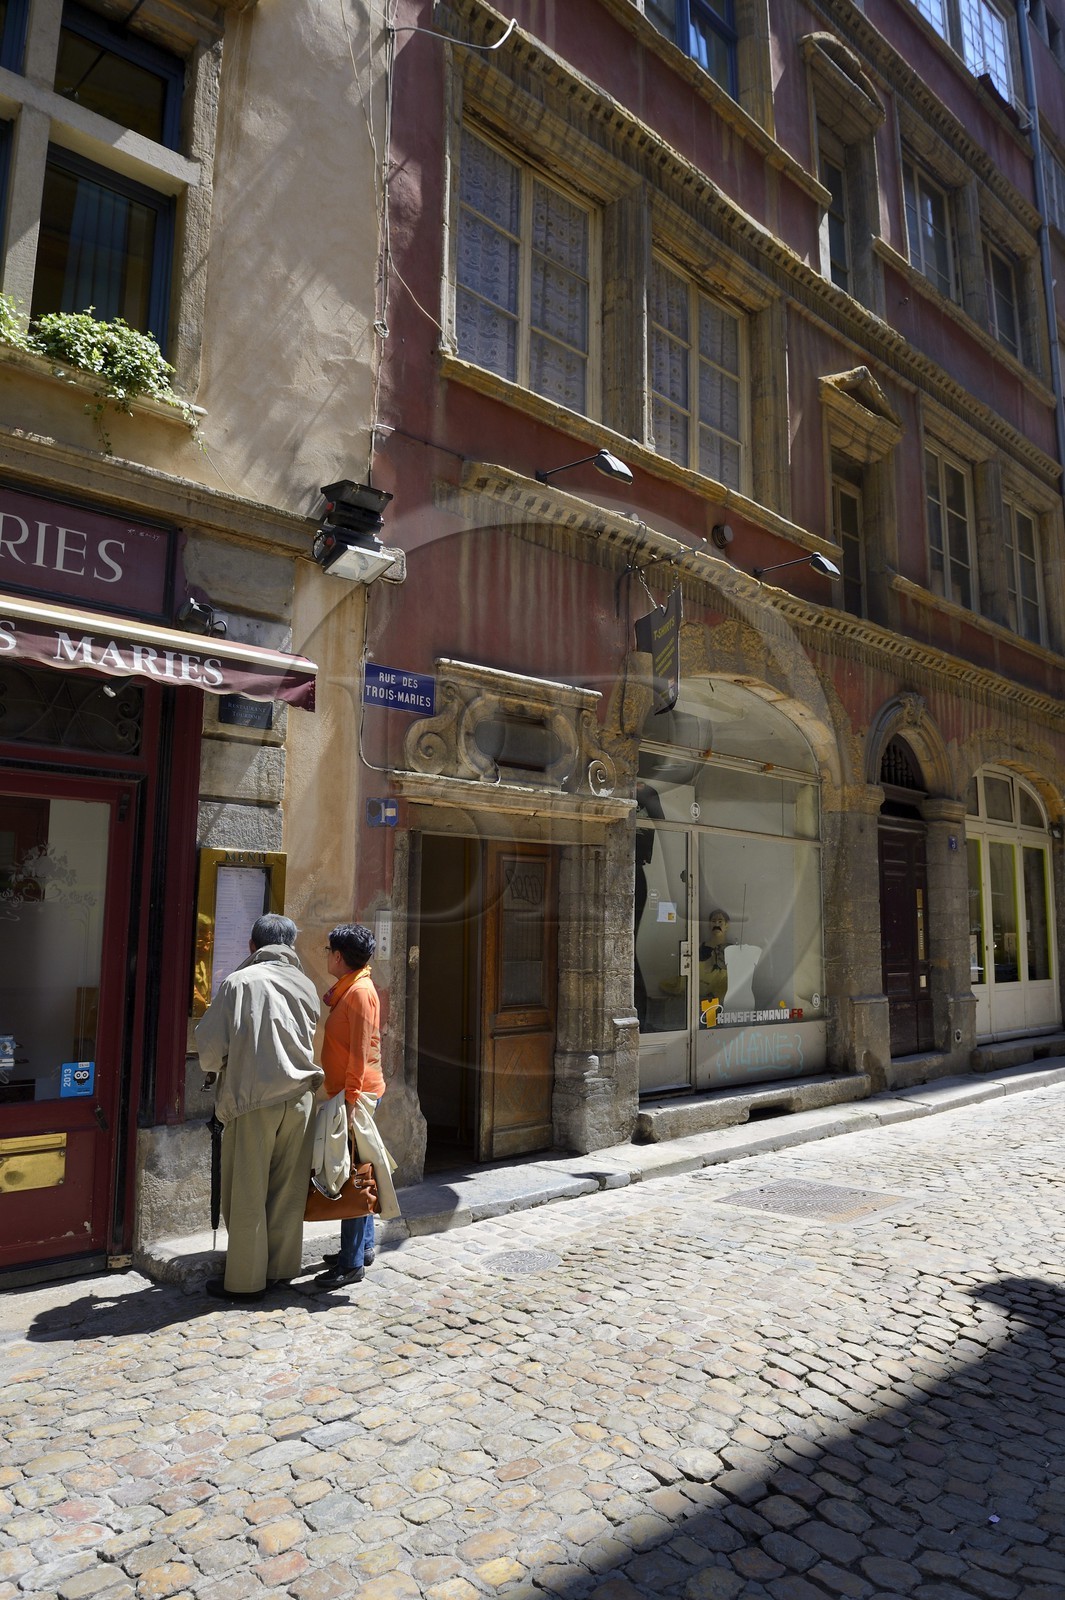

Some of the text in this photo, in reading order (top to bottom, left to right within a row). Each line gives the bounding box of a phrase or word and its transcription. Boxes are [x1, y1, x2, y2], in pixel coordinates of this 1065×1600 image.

[0, 511, 125, 583] RIES
[0, 620, 224, 686] S MARIES
[379, 671, 418, 689] RUE DES
[225, 850, 267, 864] MENU
[63, 1068, 72, 1087] 2013
